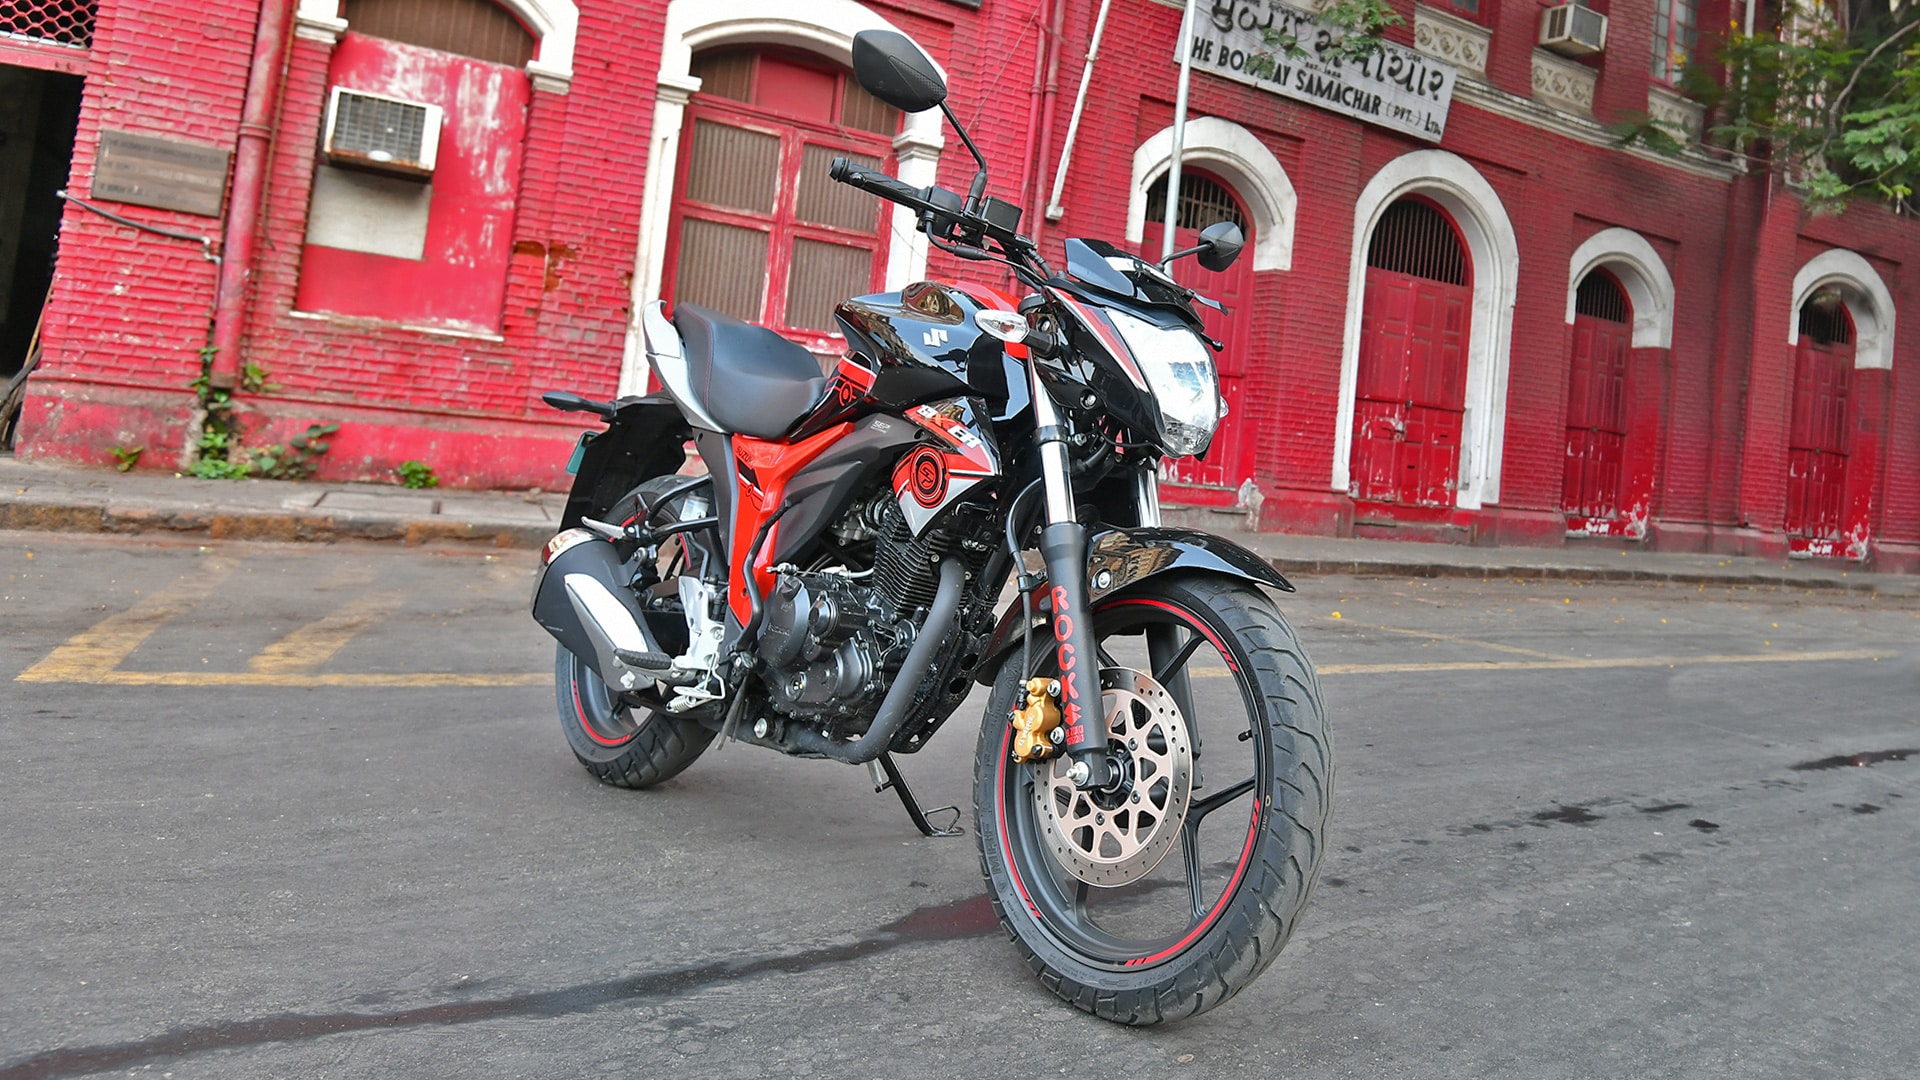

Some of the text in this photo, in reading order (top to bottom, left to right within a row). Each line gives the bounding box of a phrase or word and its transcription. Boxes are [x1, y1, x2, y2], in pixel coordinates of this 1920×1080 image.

[1190, 36, 1214, 62] HE
[1217, 45, 1292, 87] BOAY
[1295, 69, 1381, 116] SAMACHAR
